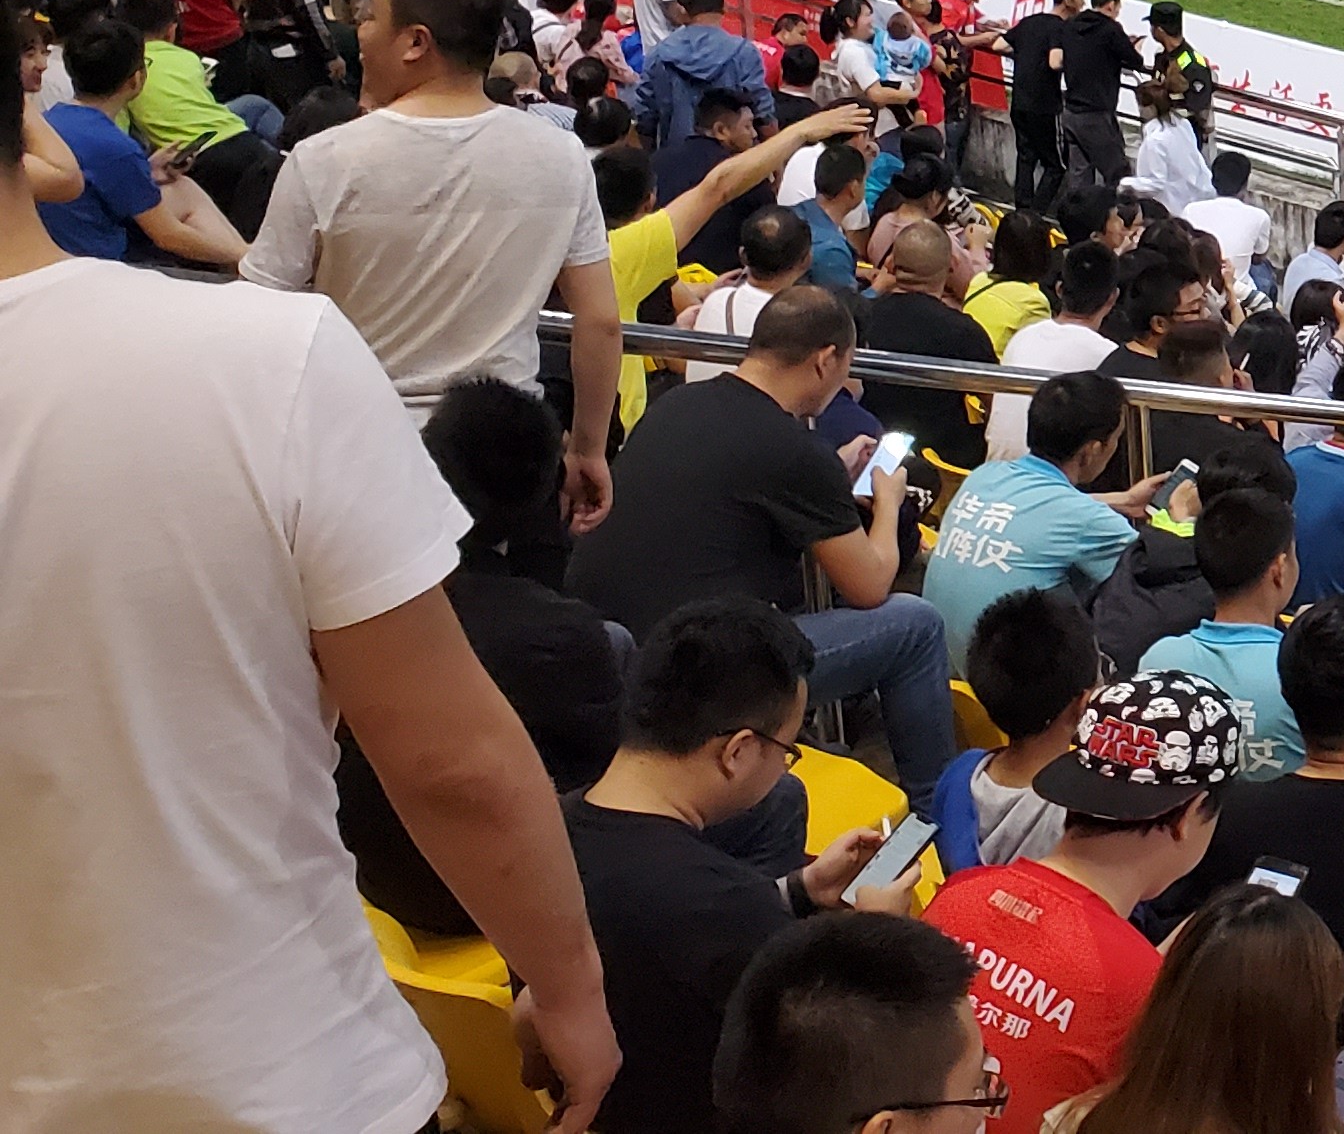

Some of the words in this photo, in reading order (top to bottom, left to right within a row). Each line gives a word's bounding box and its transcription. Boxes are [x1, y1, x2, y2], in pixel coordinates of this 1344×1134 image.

[935, 527, 1024, 574] 阵仗
[1087, 732, 1160, 769] WARS
[1093, 715, 1160, 751] STAR
